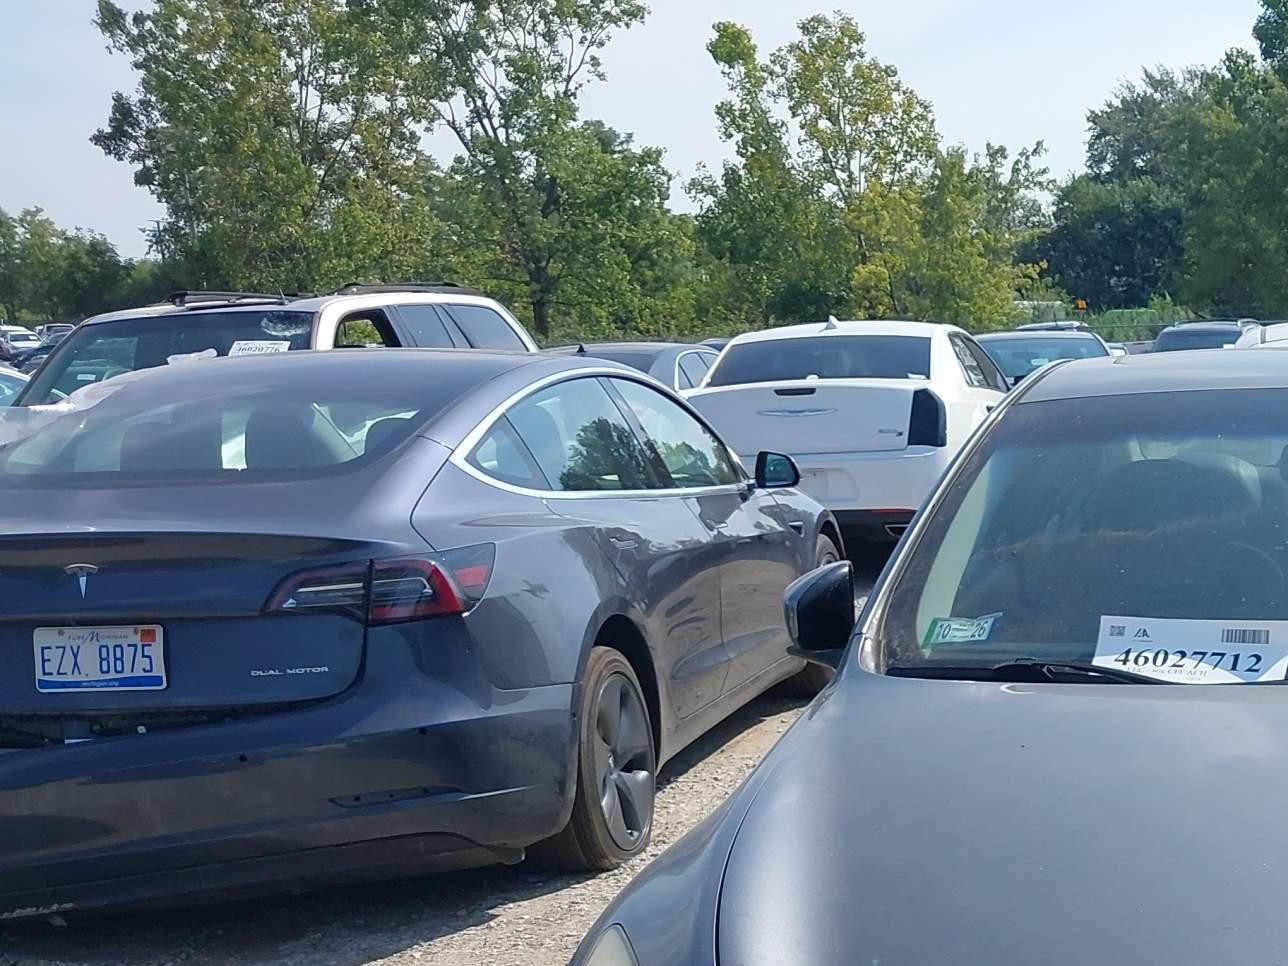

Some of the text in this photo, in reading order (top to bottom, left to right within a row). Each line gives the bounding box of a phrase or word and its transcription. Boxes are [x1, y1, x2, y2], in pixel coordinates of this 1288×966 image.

[40, 643, 154, 677] EZX 8875
[285, 666, 329, 674] MOTOR
[1114, 647, 1263, 673] 46027712
